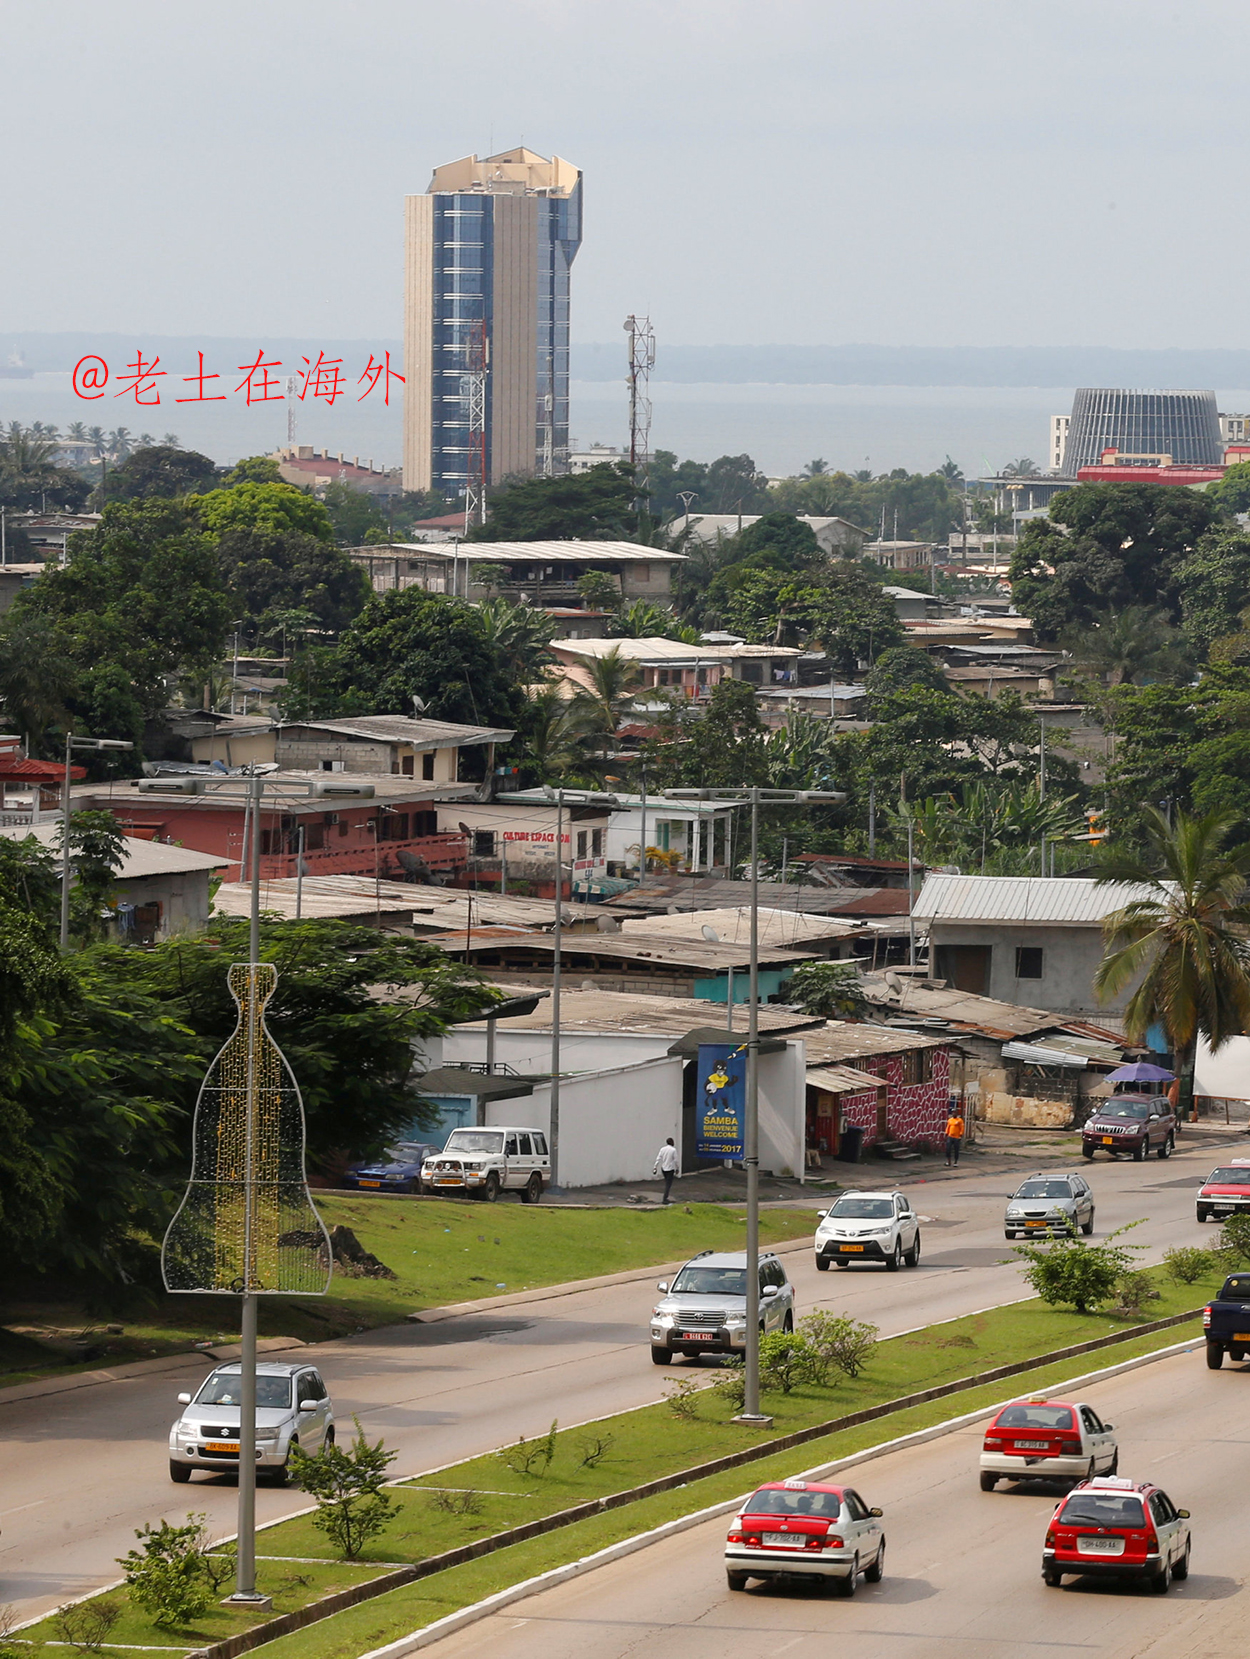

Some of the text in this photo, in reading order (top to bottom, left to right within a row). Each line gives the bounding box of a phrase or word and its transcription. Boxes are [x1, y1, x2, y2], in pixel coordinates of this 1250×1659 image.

[503, 831, 529, 842] CULTURE
[531, 832, 555, 843] ESPACE
[703, 1116, 738, 1125] SAMBA
[721, 1145, 741, 1153] 2017
